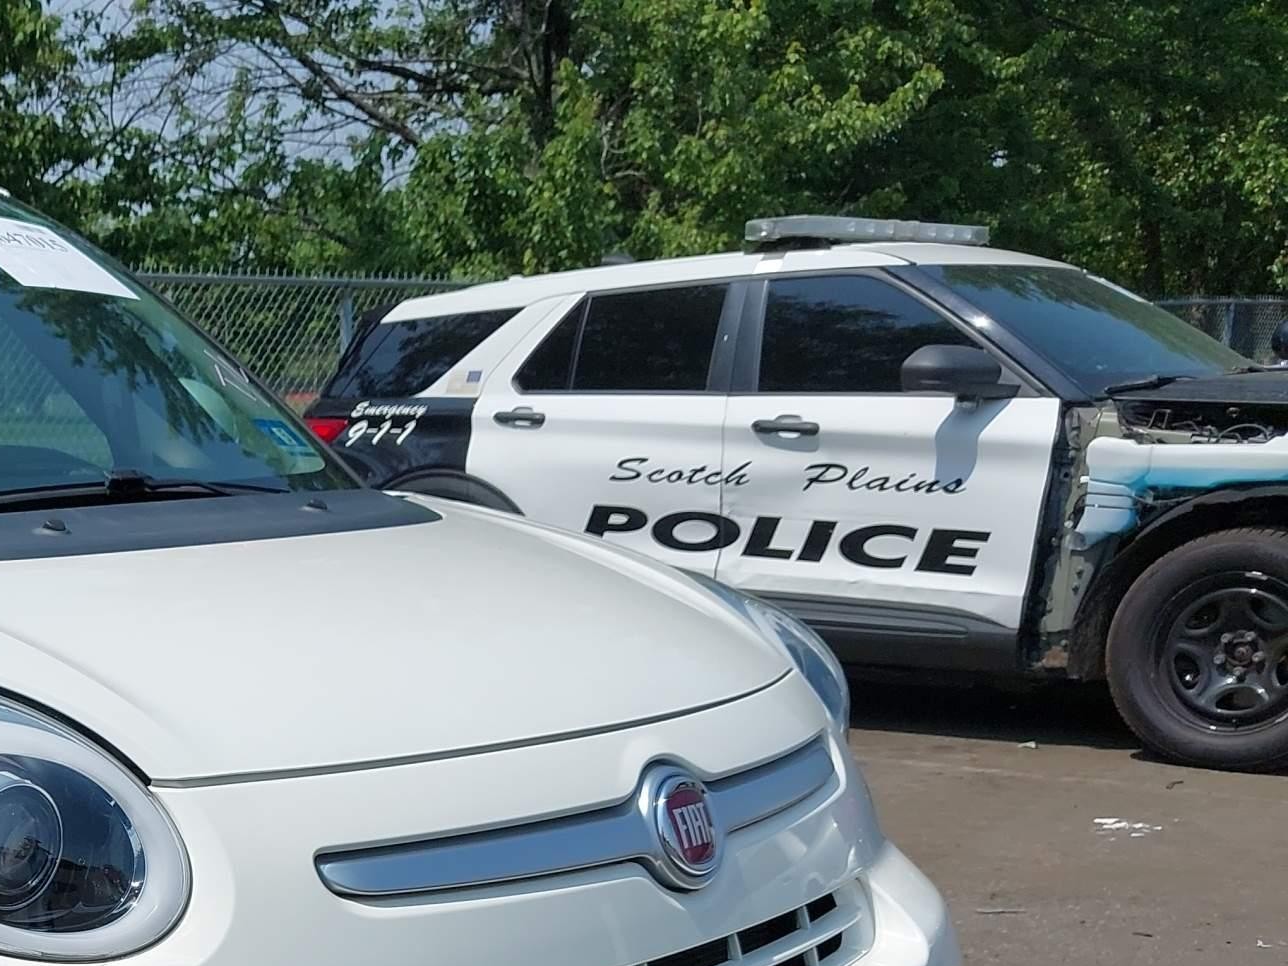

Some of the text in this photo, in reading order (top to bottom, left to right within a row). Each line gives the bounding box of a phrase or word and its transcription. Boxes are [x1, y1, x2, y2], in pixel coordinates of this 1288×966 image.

[350, 399, 429, 419] Emergency
[608, 456, 968, 495] Scotch Plains
[583, 503, 992, 576] POLICE
[671, 802, 712, 849] FIAT
